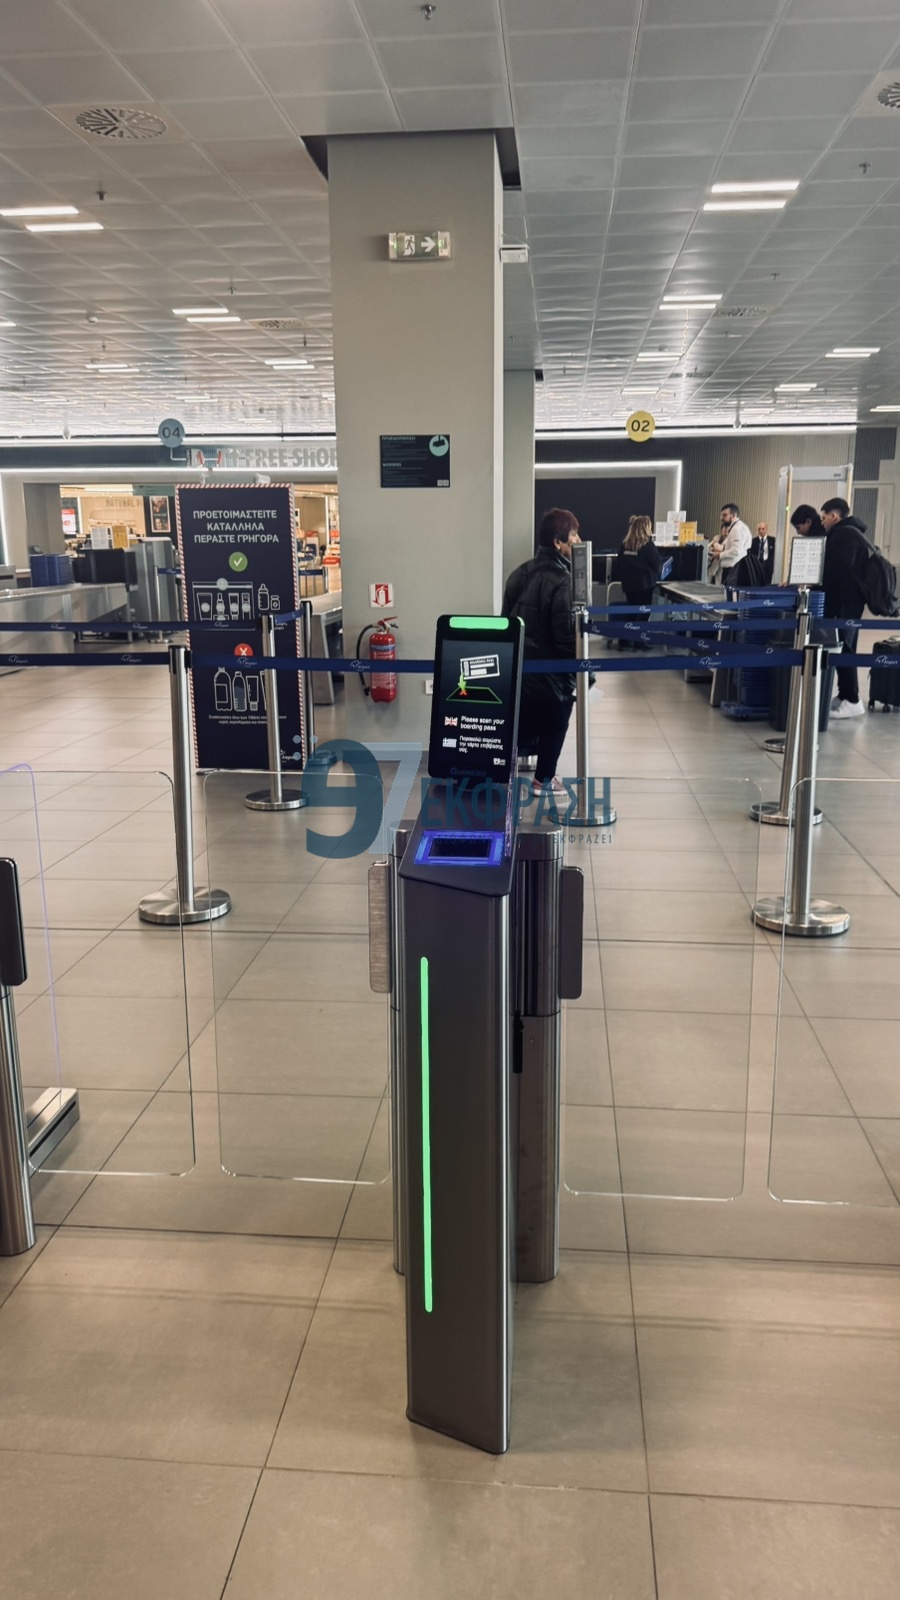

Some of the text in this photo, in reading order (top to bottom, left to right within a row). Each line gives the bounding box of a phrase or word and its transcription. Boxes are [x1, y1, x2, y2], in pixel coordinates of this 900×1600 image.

[631, 419, 650, 432] 02
[162, 427, 181, 439] 04
[193, 510, 278, 519] ΠΡΟΕΤΟΙΜΑΣΤΕΙΤΕ
[207, 522, 265, 531] ΚΑΤΑΛΛΗΛΑ
[194, 534, 279, 543] ΠΕΡΑΣΤΕ ΓΡΗΓΟΡΑ
[461, 715, 479, 723] Please
[460, 722, 483, 731] boarding
